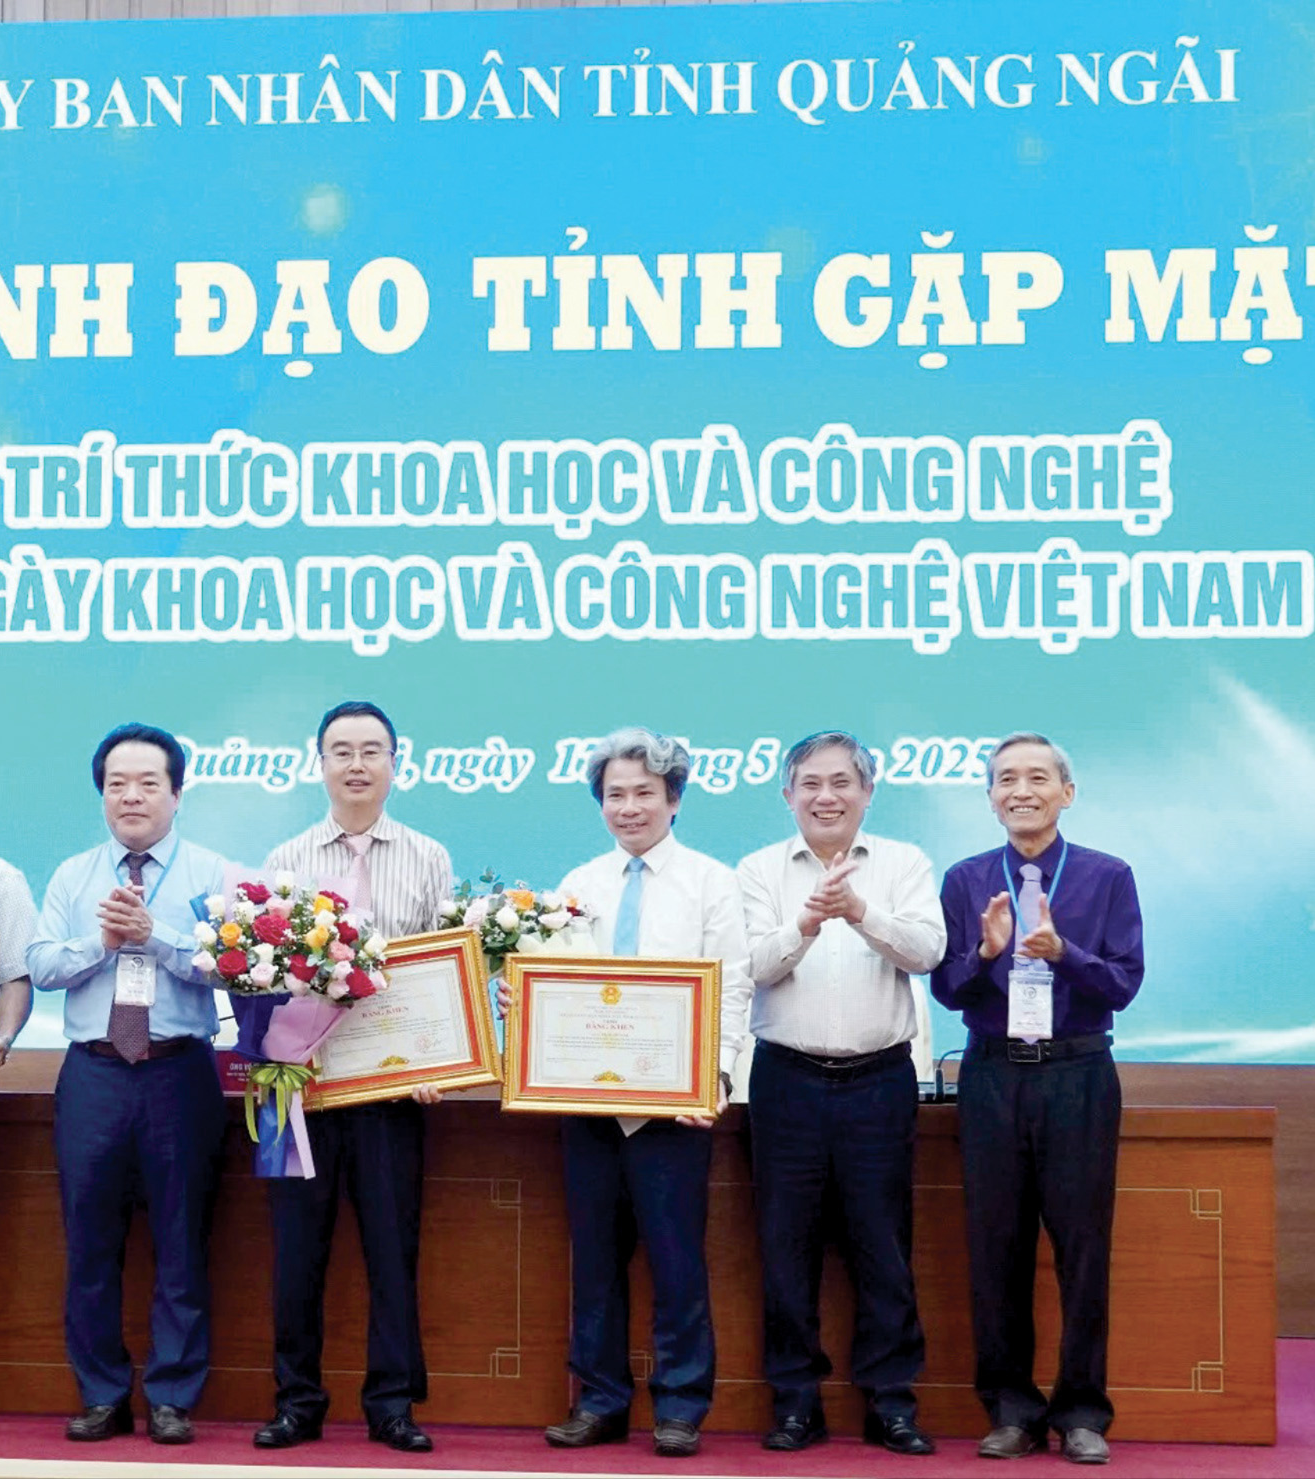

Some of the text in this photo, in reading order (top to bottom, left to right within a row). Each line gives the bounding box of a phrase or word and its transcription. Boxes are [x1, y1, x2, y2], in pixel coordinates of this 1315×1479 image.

[51, 74, 186, 131] BAN
[206, 53, 401, 128] NHÂN
[420, 48, 566, 122] DÂN
[583, 46, 759, 118] TỈNH
[776, 40, 1037, 127] QUẢNG
[1054, 34, 1241, 108] NGÃI
[174, 255, 430, 379] ĐẠO
[472, 226, 784, 352] TỈNH
[812, 230, 1064, 370] GẶP
[1, 427, 1166, 533] TRÍ THỨC KHOA HỌC VÀ CÔNG NGHỆ
[110, 563, 295, 636] KHOA
[303, 561, 442, 650] HỌC
[455, 549, 551, 634] VÀ
[561, 547, 752, 633] CÔNG
[769, 546, 956, 648] NGHỆ
[970, 545, 1126, 648] VIỆT
[1139, 558, 1307, 632] NAM
[183, 740, 297, 788] uảng
[426, 738, 531, 788] ngày
[748, 742, 775, 780] 5
